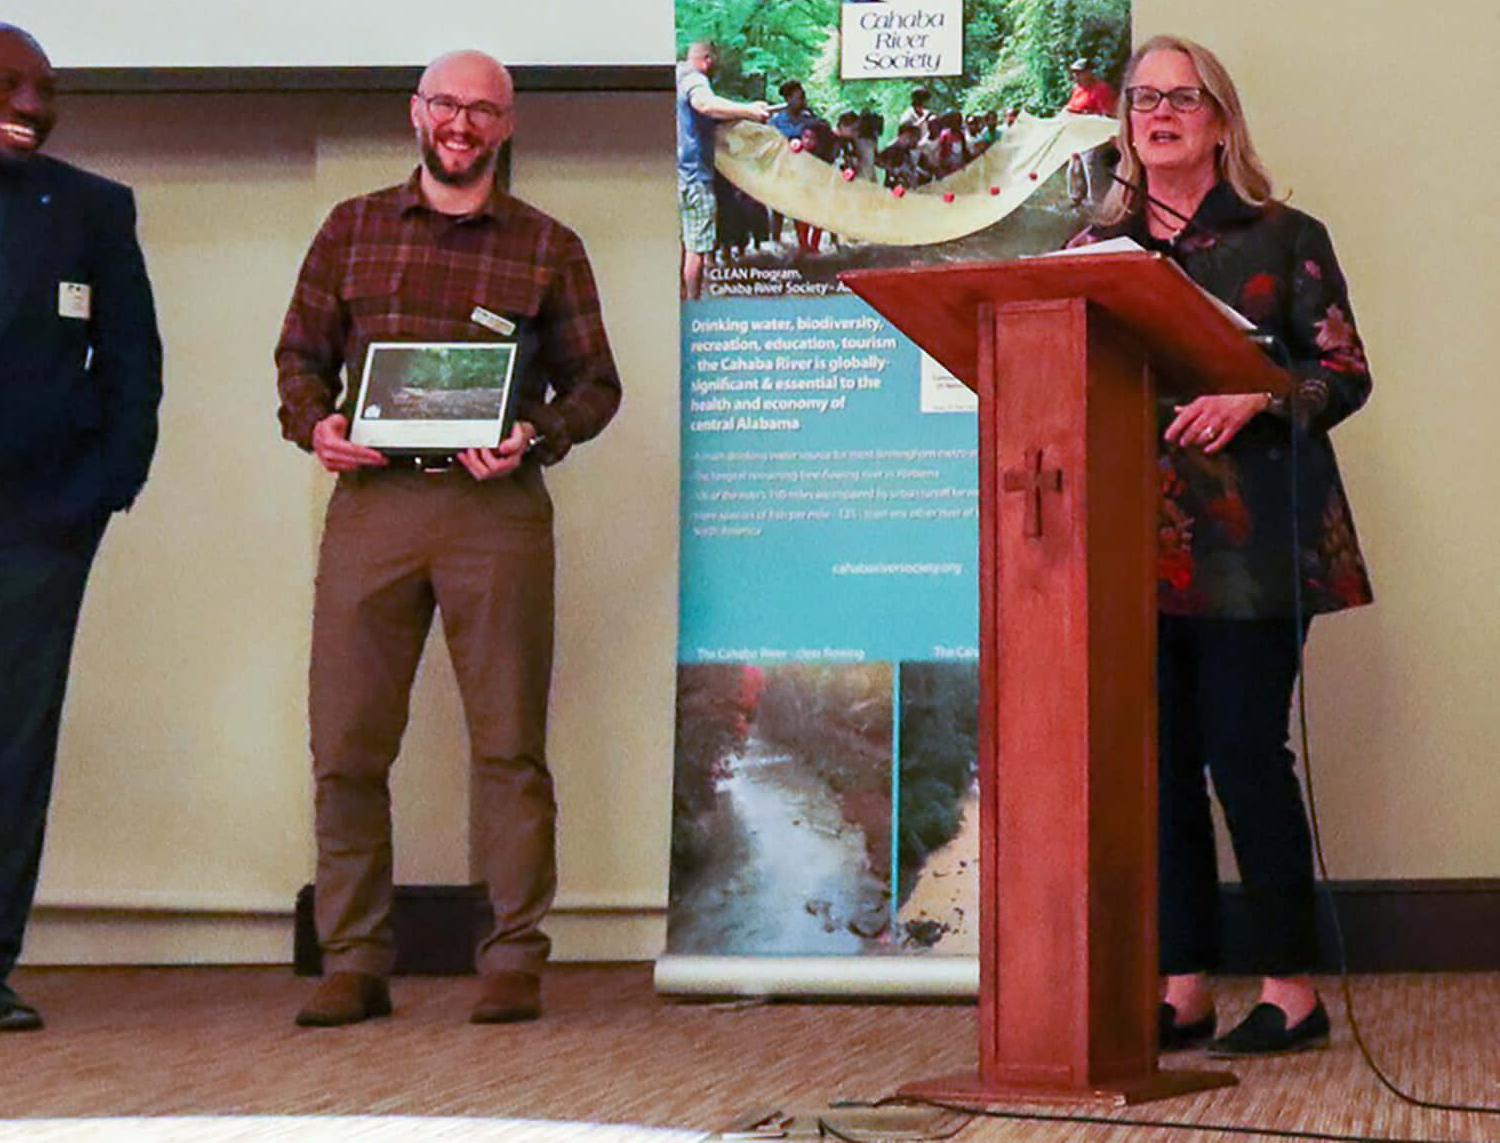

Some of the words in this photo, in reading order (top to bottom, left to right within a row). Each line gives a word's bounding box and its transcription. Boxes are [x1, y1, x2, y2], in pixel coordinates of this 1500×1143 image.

[859, 10, 945, 31] Cahaba
[875, 32, 929, 49] River
[862, 51, 942, 72] Society
[709, 268, 747, 280] CLEAN
[709, 282, 752, 294] Cahaba
[754, 281, 783, 293] River
[786, 281, 828, 295] Society
[691, 318, 749, 334] Drinking
[751, 319, 794, 332] water,
[797, 316, 885, 331] biodiversity,
[691, 337, 761, 352] recreation,
[764, 337, 840, 350] education,
[842, 336, 896, 349] tourism
[720, 357, 773, 370] Cahaba
[776, 356, 812, 369] River
[815, 356, 826, 369] is
[691, 377, 759, 394] significant
[761, 376, 773, 389] &
[775, 375, 838, 389] essential
[840, 376, 855, 388] to
[857, 374, 882, 388] the
[691, 398, 731, 411] health
[734, 396, 761, 410] and
[763, 399, 828, 413] economy
[830, 395, 846, 408] of
[690, 418, 733, 431] central
[736, 416, 800, 430] Alabama
